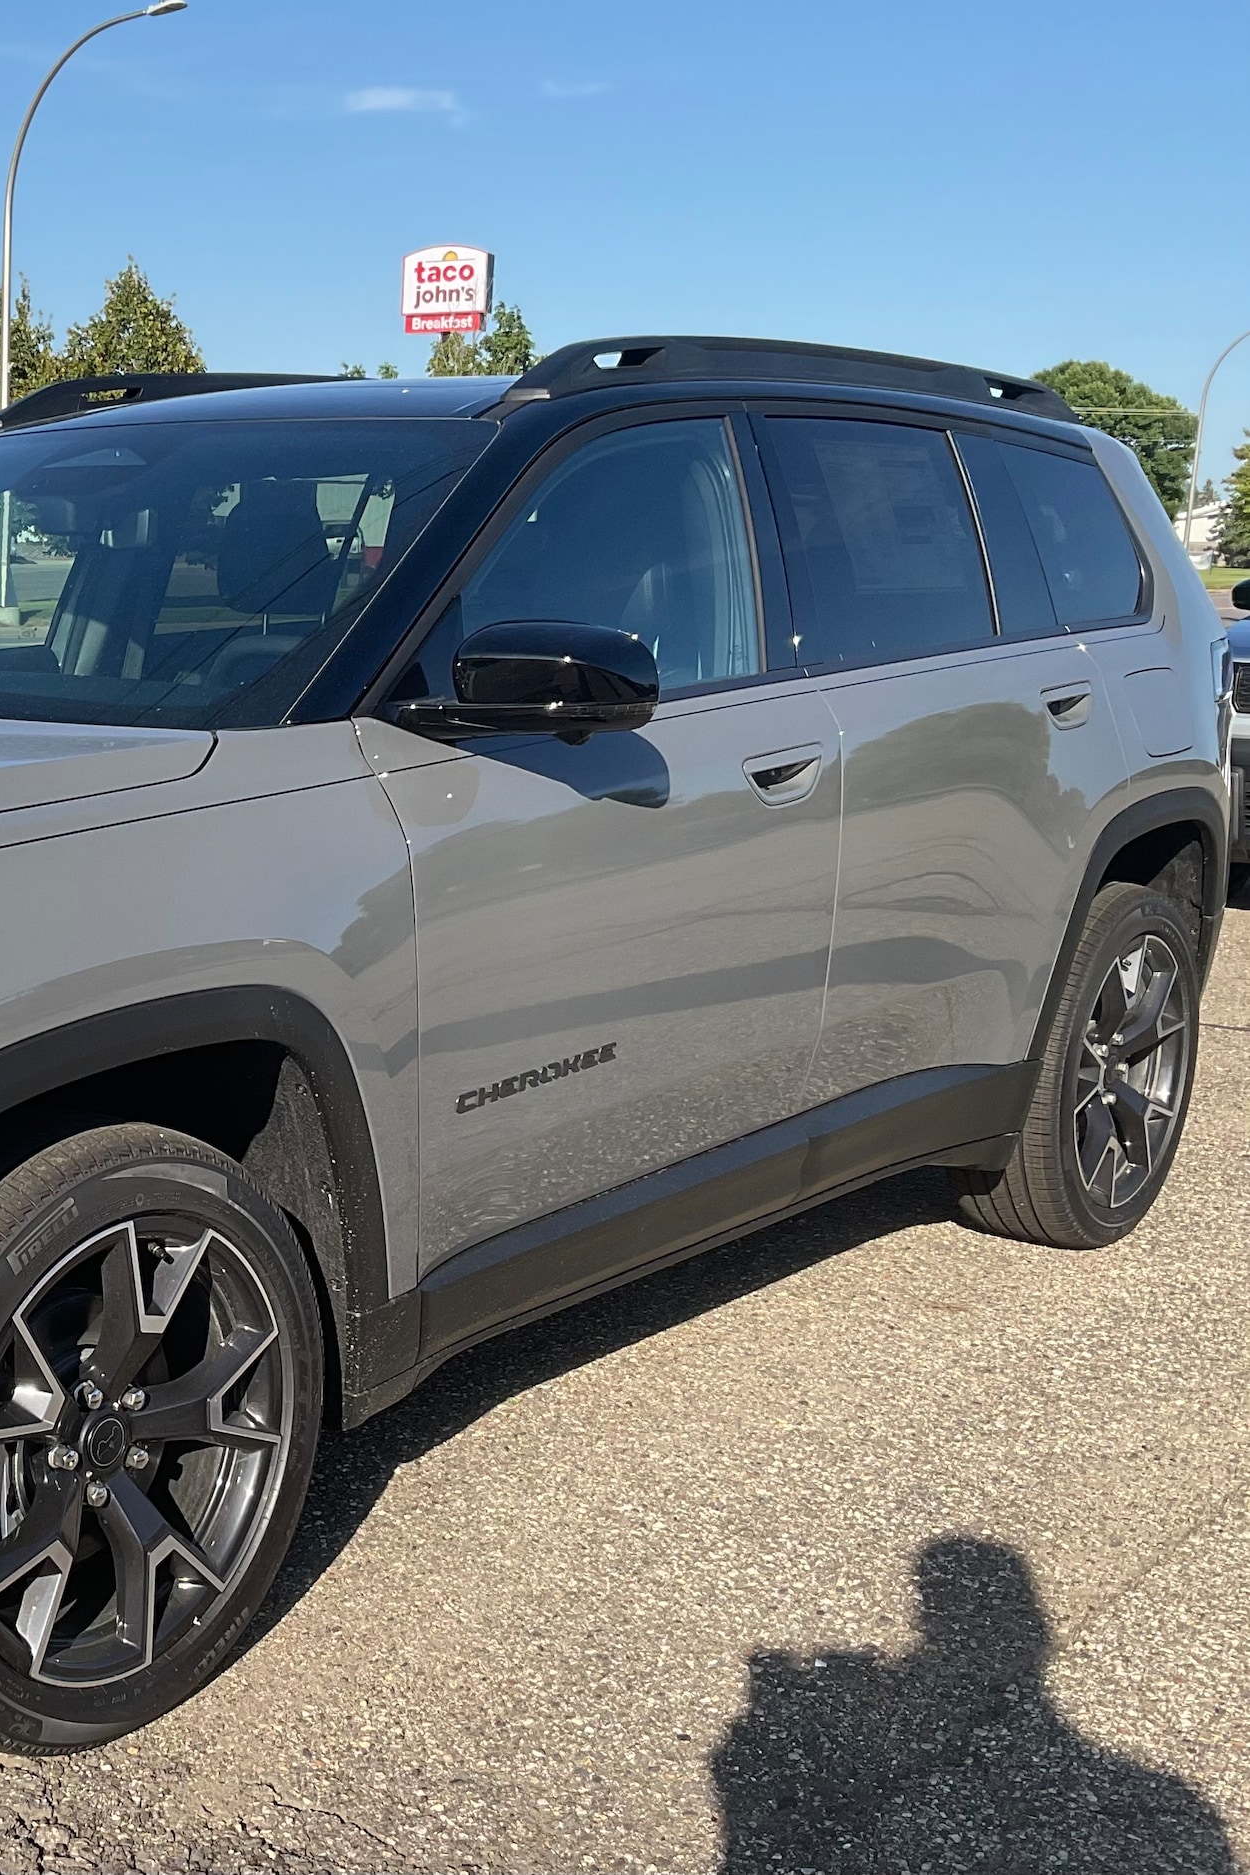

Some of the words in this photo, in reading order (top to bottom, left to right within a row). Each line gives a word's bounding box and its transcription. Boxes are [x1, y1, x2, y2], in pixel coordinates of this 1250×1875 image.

[414, 262, 474, 284] taco
[414, 285, 474, 309] john's
[411, 315, 473, 330] Breakfast
[455, 1042, 617, 1115] CHEROKEE
[6, 1197, 80, 1276] PIRELLI
